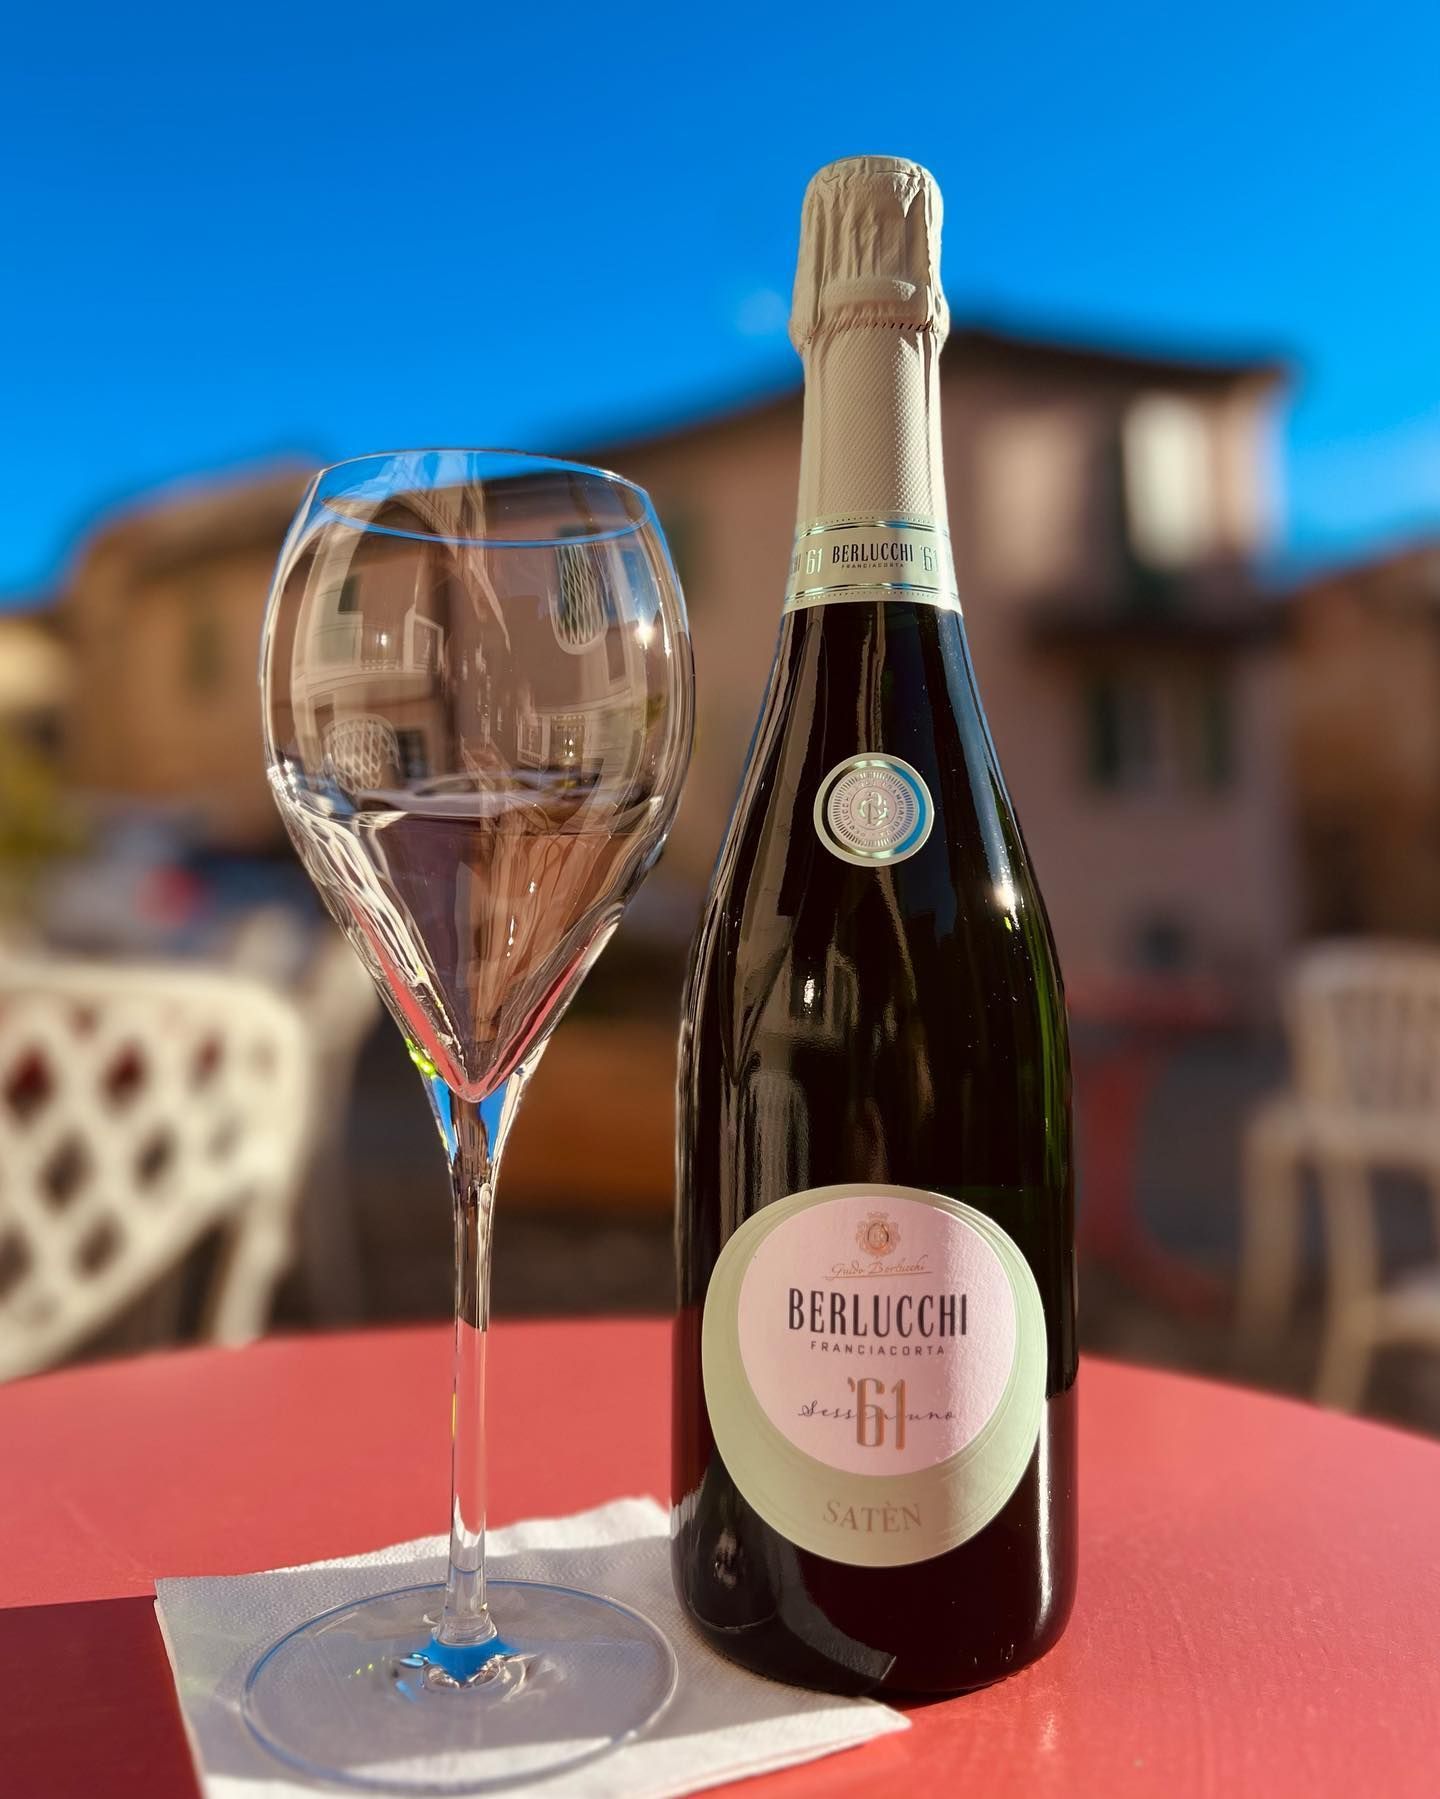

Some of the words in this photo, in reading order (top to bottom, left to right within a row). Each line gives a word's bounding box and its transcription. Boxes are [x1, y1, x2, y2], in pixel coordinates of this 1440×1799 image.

[832, 543, 913, 564] BERLUCCHI
[841, 561, 904, 569] FRANCIACORTA
[826, 1260, 864, 1279] Guido
[788, 1287, 968, 1338] BERLUCCHI
[810, 1340, 945, 1356] FRANCIACORTA
[847, 1376, 906, 1451] '61
[823, 1501, 922, 1534] SATÈN
